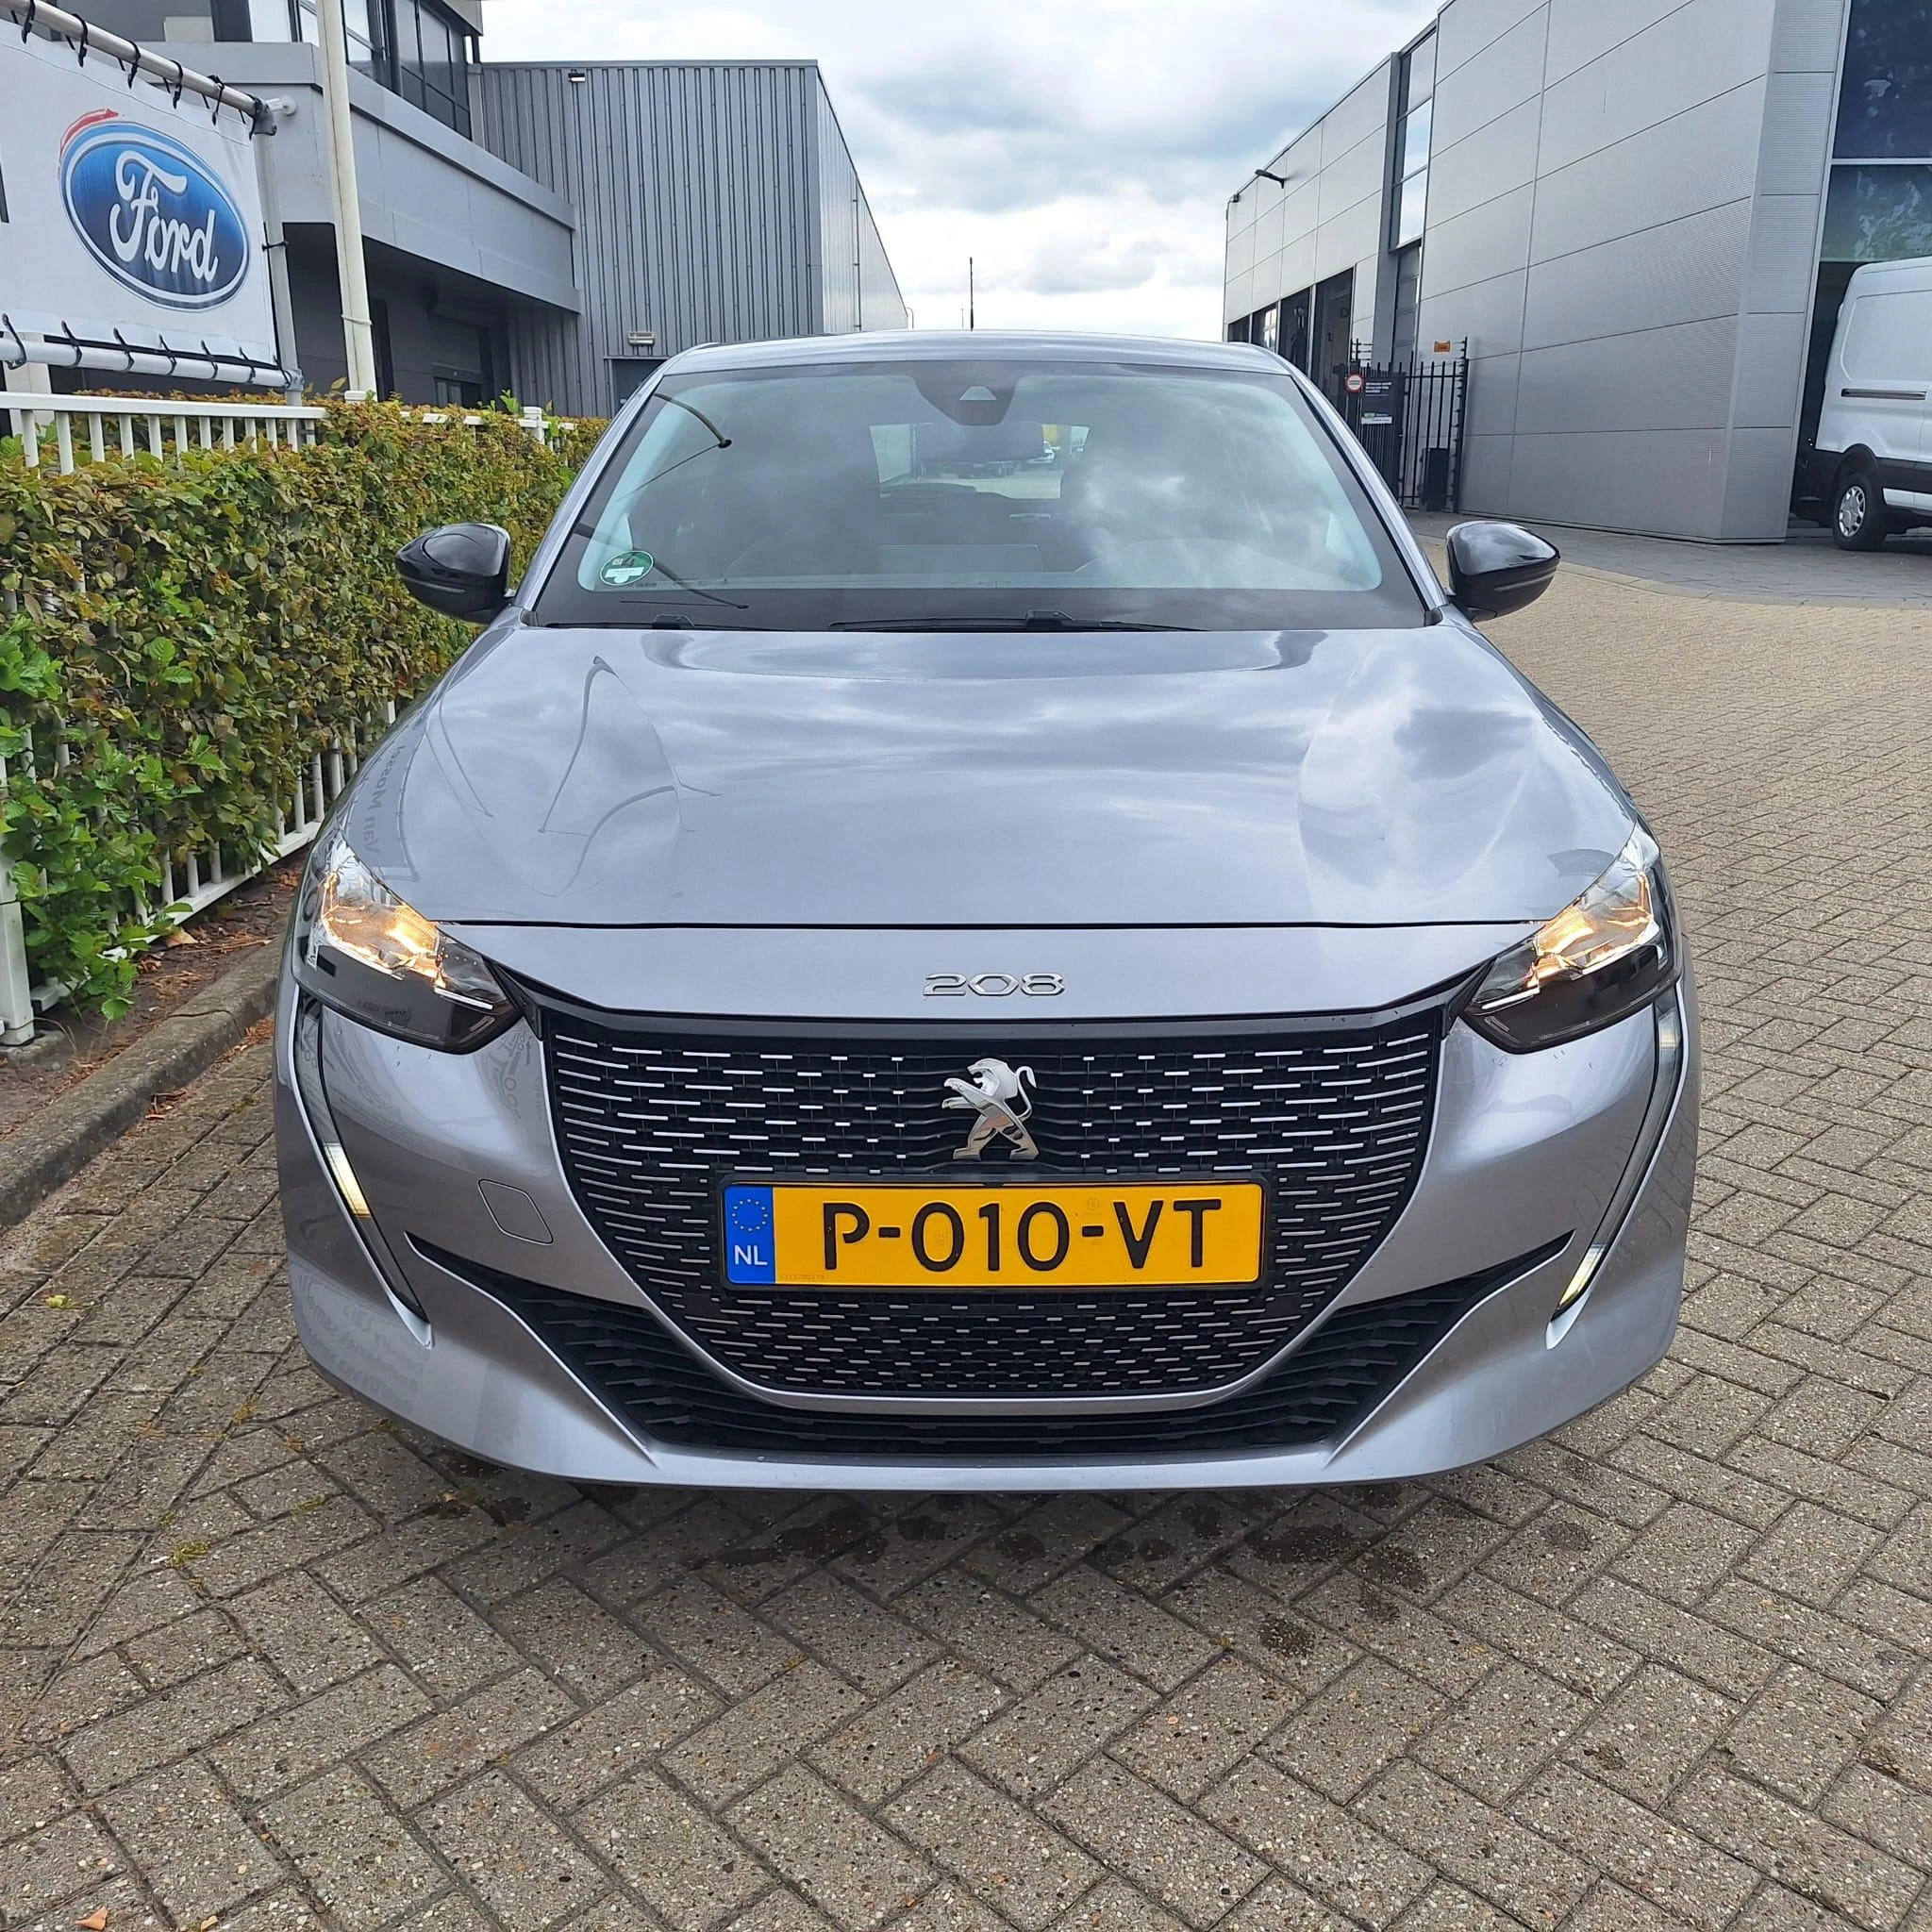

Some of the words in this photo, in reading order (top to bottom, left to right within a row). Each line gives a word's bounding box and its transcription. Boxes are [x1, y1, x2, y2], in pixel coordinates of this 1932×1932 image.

[108, 149, 219, 282] Ford
[922, 973, 1065, 997] 208
[734, 1244, 769, 1267] NL
[822, 1197, 1223, 1273] P-010-VT
